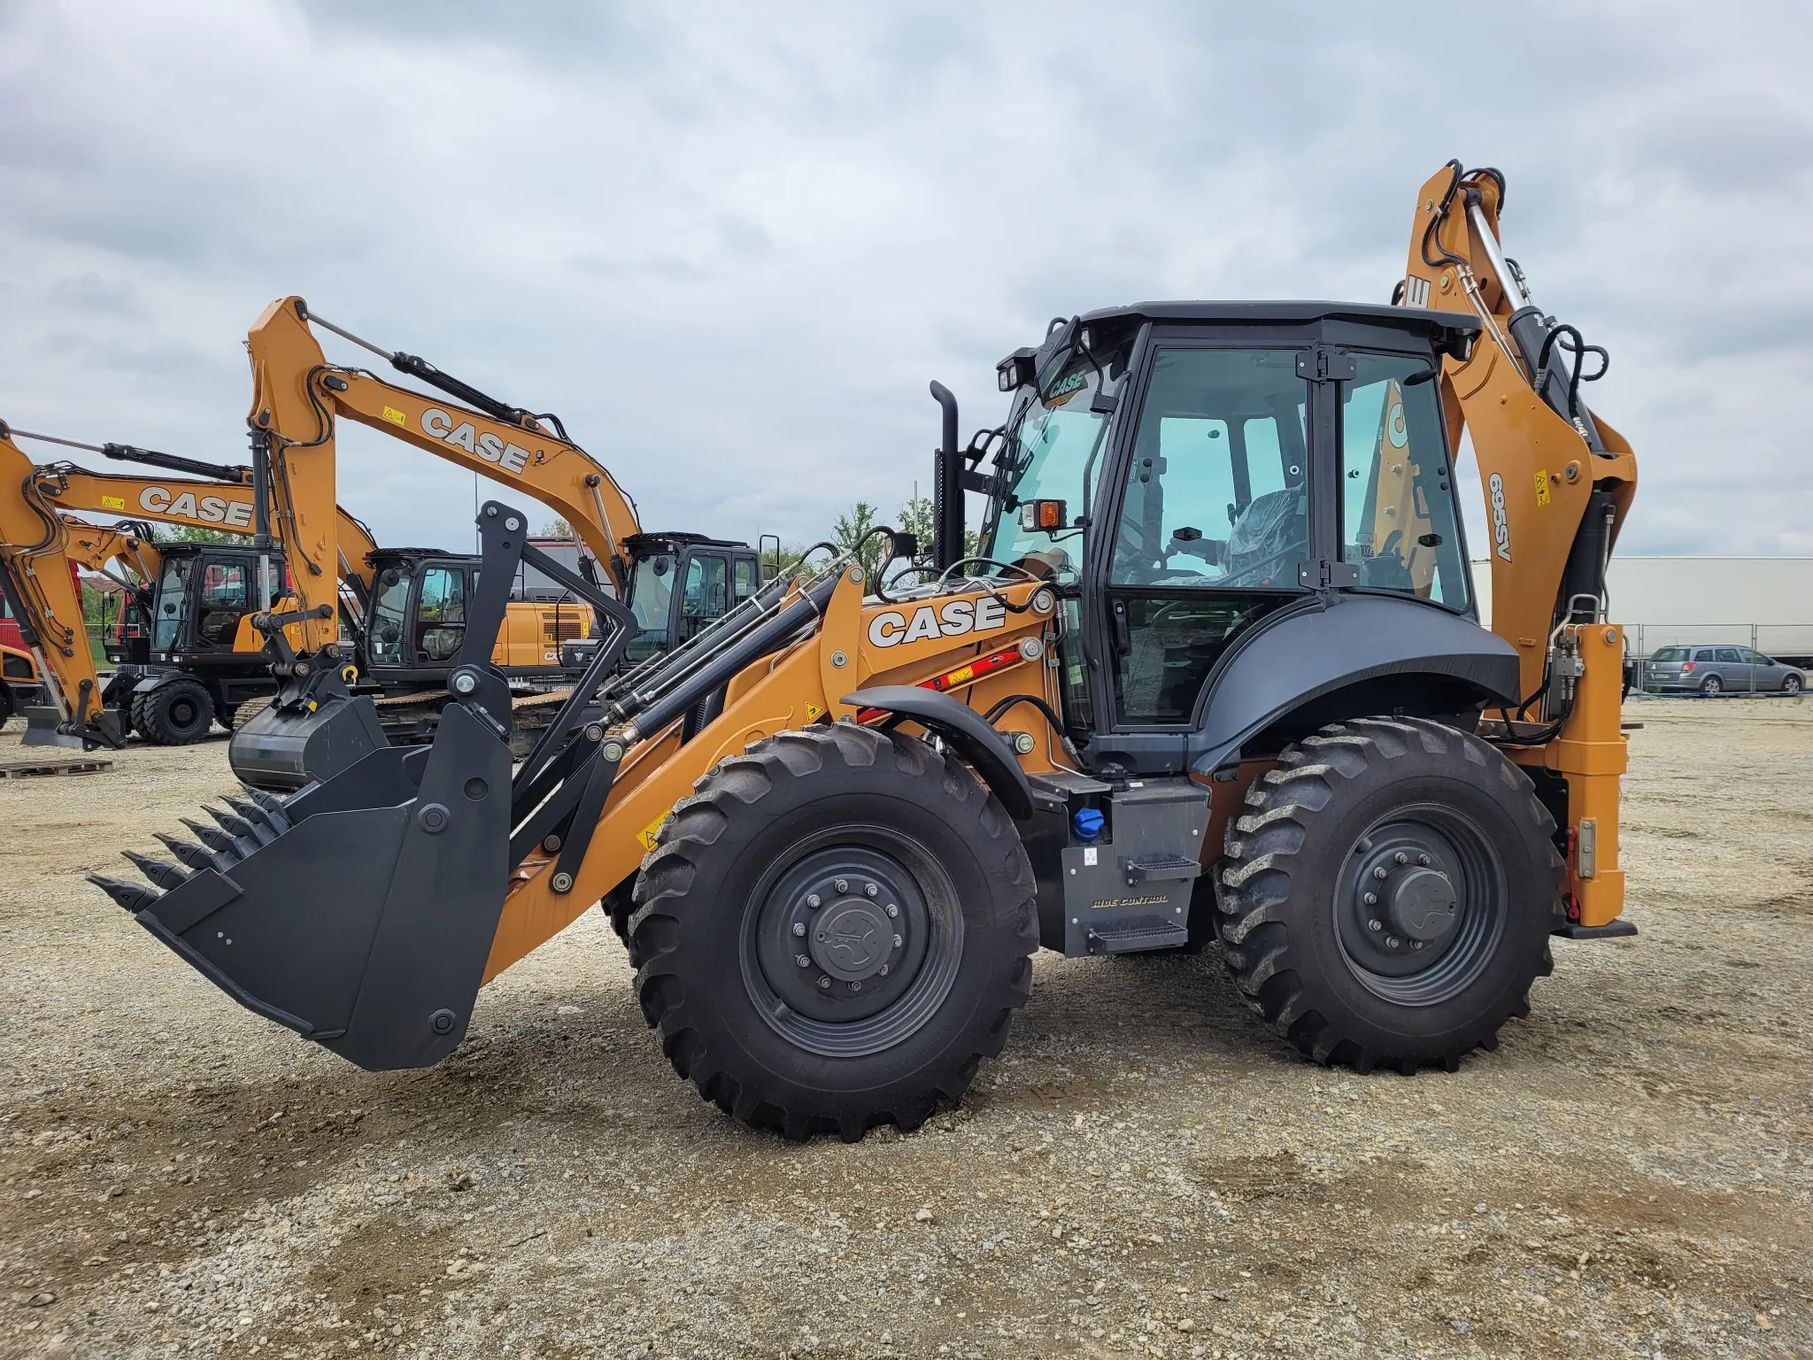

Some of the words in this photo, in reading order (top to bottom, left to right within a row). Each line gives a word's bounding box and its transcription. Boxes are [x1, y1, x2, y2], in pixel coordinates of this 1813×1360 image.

[1049, 369, 1086, 399] CASE
[420, 407, 531, 475] CASE
[138, 485, 255, 528] CASE
[1488, 472, 1513, 564] 695SV
[867, 593, 1008, 649] CASE
